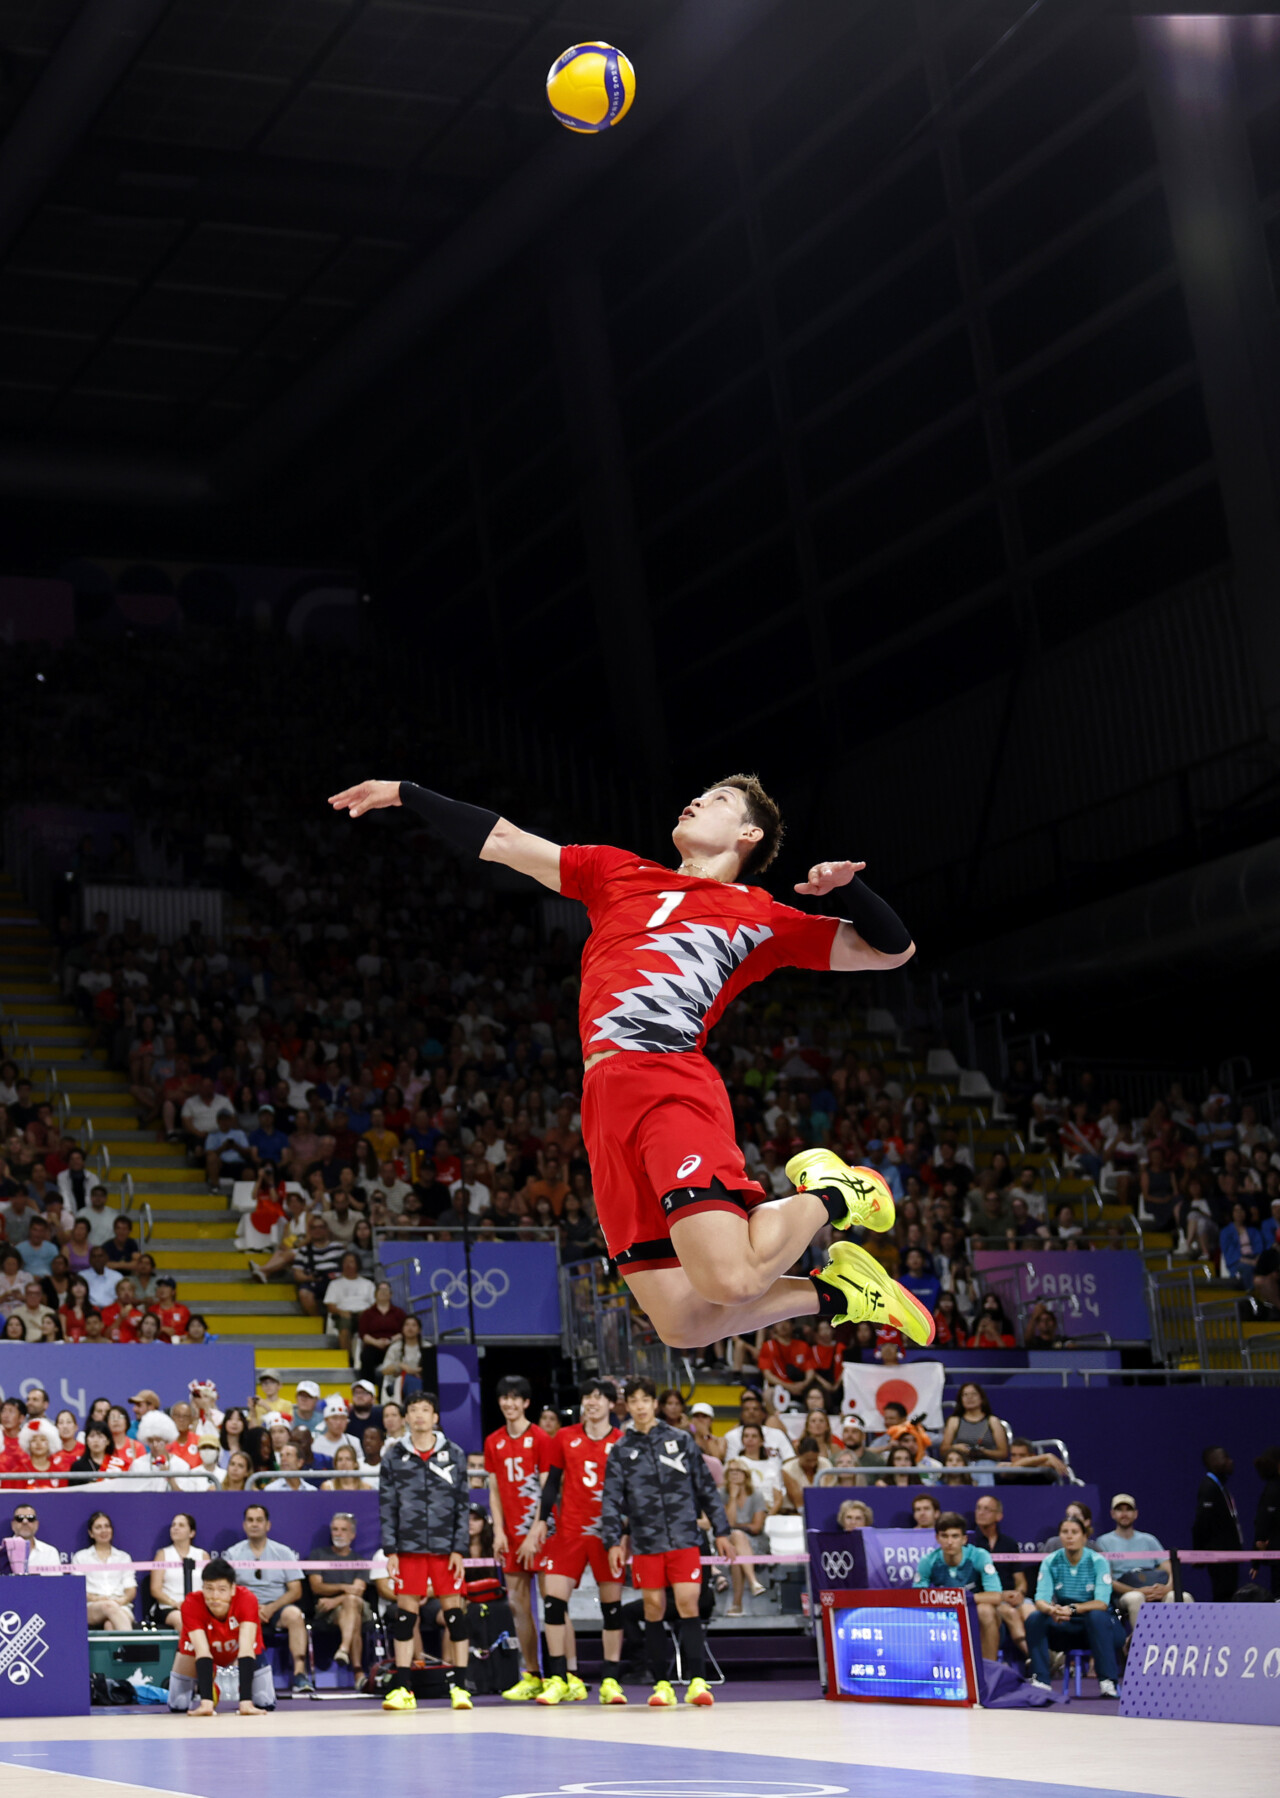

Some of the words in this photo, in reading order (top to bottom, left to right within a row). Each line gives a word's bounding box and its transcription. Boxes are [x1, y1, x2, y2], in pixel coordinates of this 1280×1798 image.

[1026, 1274, 1097, 1295] PARIS
[505, 1457, 524, 1482] 15
[582, 1461, 598, 1487] 5
[929, 1589, 964, 1605] OMEGA
[1142, 1644, 1230, 1678] PARIS
